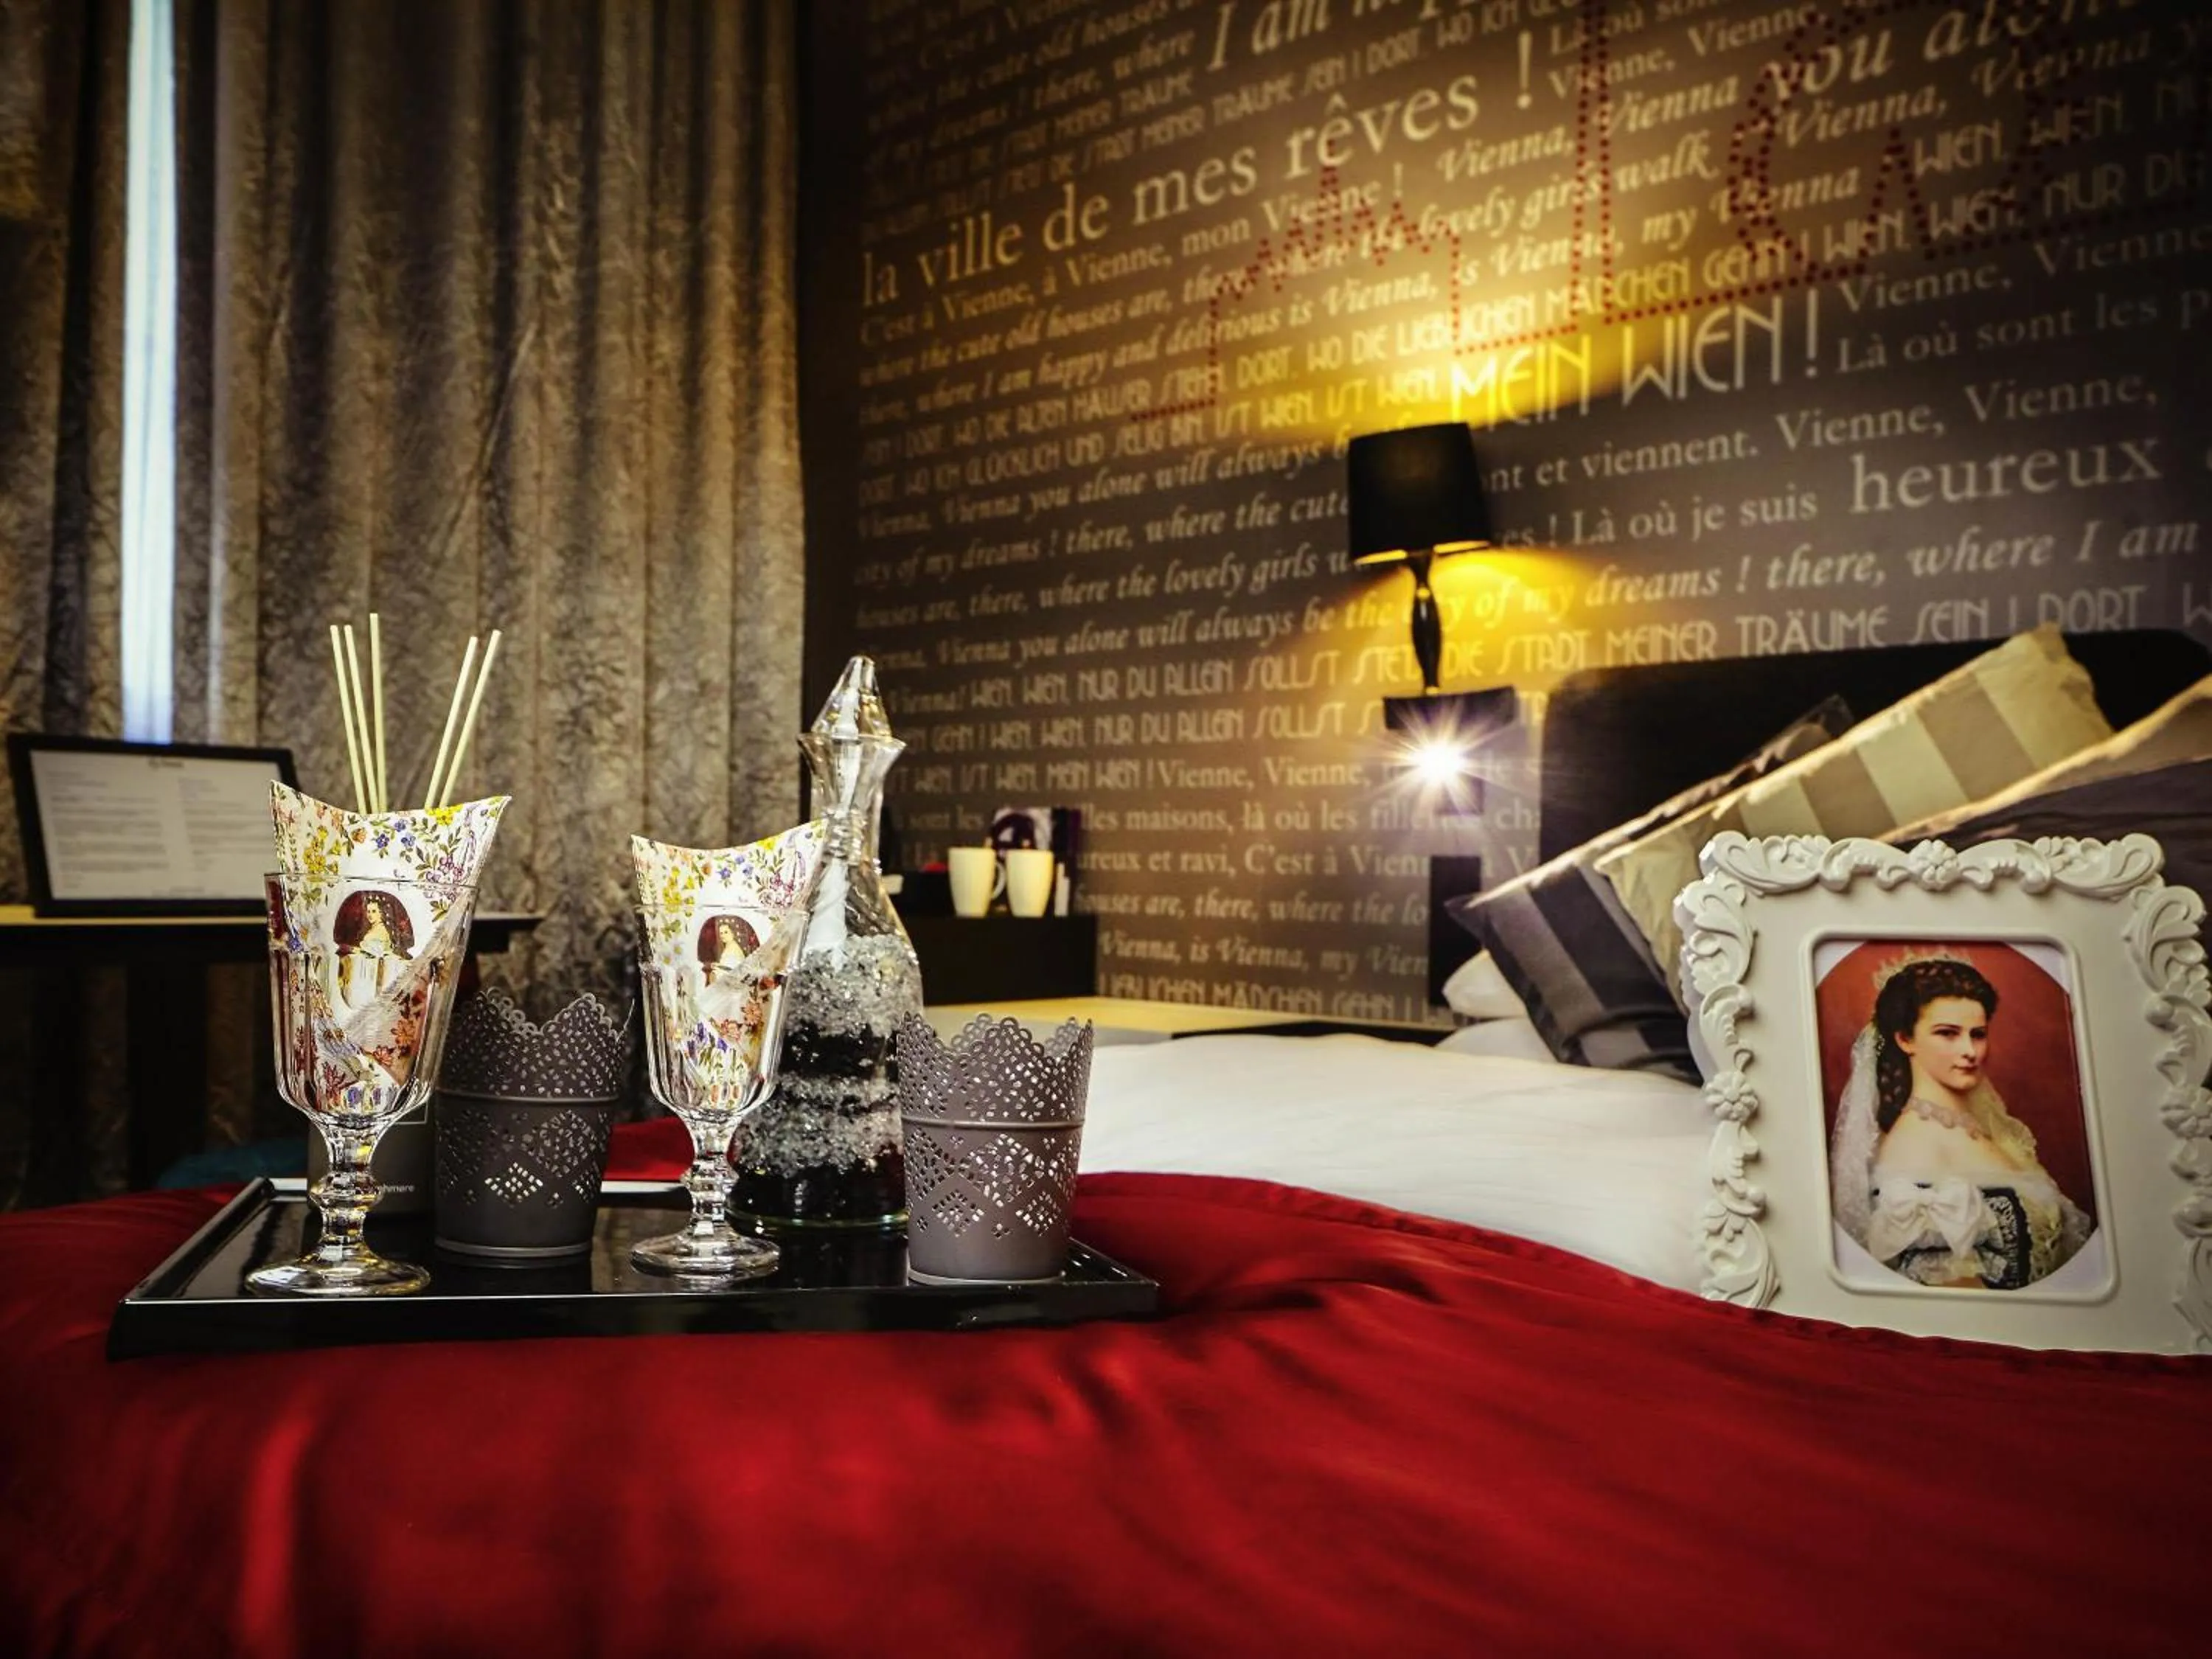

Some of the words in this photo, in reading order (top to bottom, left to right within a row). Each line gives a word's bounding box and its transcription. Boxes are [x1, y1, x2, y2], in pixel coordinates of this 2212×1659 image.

[1206, 1, 1236, 71] I
[1615, 130, 1719, 192] walk
[863, 251, 900, 307] la
[917, 211, 1023, 288] ville
[1043, 181, 1110, 251] de
[1132, 147, 1257, 225] mes
[1283, 74, 1481, 179] rêves
[1182, 218, 1251, 257] mon
[1642, 208, 1698, 251] my
[1839, 262, 2012, 313] Vienne,
[1307, 335, 1343, 372] WO
[1839, 334, 1887, 372] Là
[1902, 320, 1959, 361] où
[1975, 308, 2076, 350] sont
[2096, 292, 2158, 330] les
[1451, 334, 1591, 431] MEIN
[1623, 296, 1783, 406] WIEN
[1144, 504, 1225, 543] where
[1235, 491, 1282, 530] the
[1536, 458, 1568, 487] et
[1582, 430, 1760, 479] viennent.
[1775, 403, 1945, 451] Vienne,
[1964, 375, 2158, 422] Vienne,
[1155, 448, 1217, 490] will
[1116, 564, 1156, 599] the
[1164, 552, 1245, 598] lovely
[1249, 542, 1318, 594] girls
[1571, 507, 1615, 546] Là
[1628, 499, 1677, 539] où
[1692, 495, 1726, 542] je
[1738, 481, 1818, 526] suis
[1849, 437, 2163, 515] heureux
[1137, 609, 1195, 648] will
[1195, 606, 1294, 648] always
[1303, 597, 1336, 633] be
[1345, 591, 1394, 629] the
[1585, 564, 1722, 608] dreams
[1767, 543, 1885, 589] there,
[1906, 524, 2056, 576] where
[2075, 520, 2103, 561] I
[2118, 521, 2200, 558] am
[1244, 650, 1341, 691] SOLLST
[1498, 630, 1592, 675] STADT
[1735, 607, 1889, 658] TRÄUME
[1908, 597, 1989, 645] SEIN
[1253, 701, 1345, 739] SOLLST
[1157, 759, 1254, 791] Vienne,
[1264, 756, 1371, 787] Vienne,
[1124, 801, 1234, 835] maisons,
[1243, 800, 1265, 830] là
[1275, 800, 1310, 830] où
[1321, 799, 1357, 830] les
[1148, 851, 1171, 872] et
[1180, 843, 1237, 877] ravi,
[1244, 844, 1315, 875] C'est
[1324, 846, 1338, 875] à
[1269, 890, 1343, 922] where
[1352, 891, 1395, 924] the
